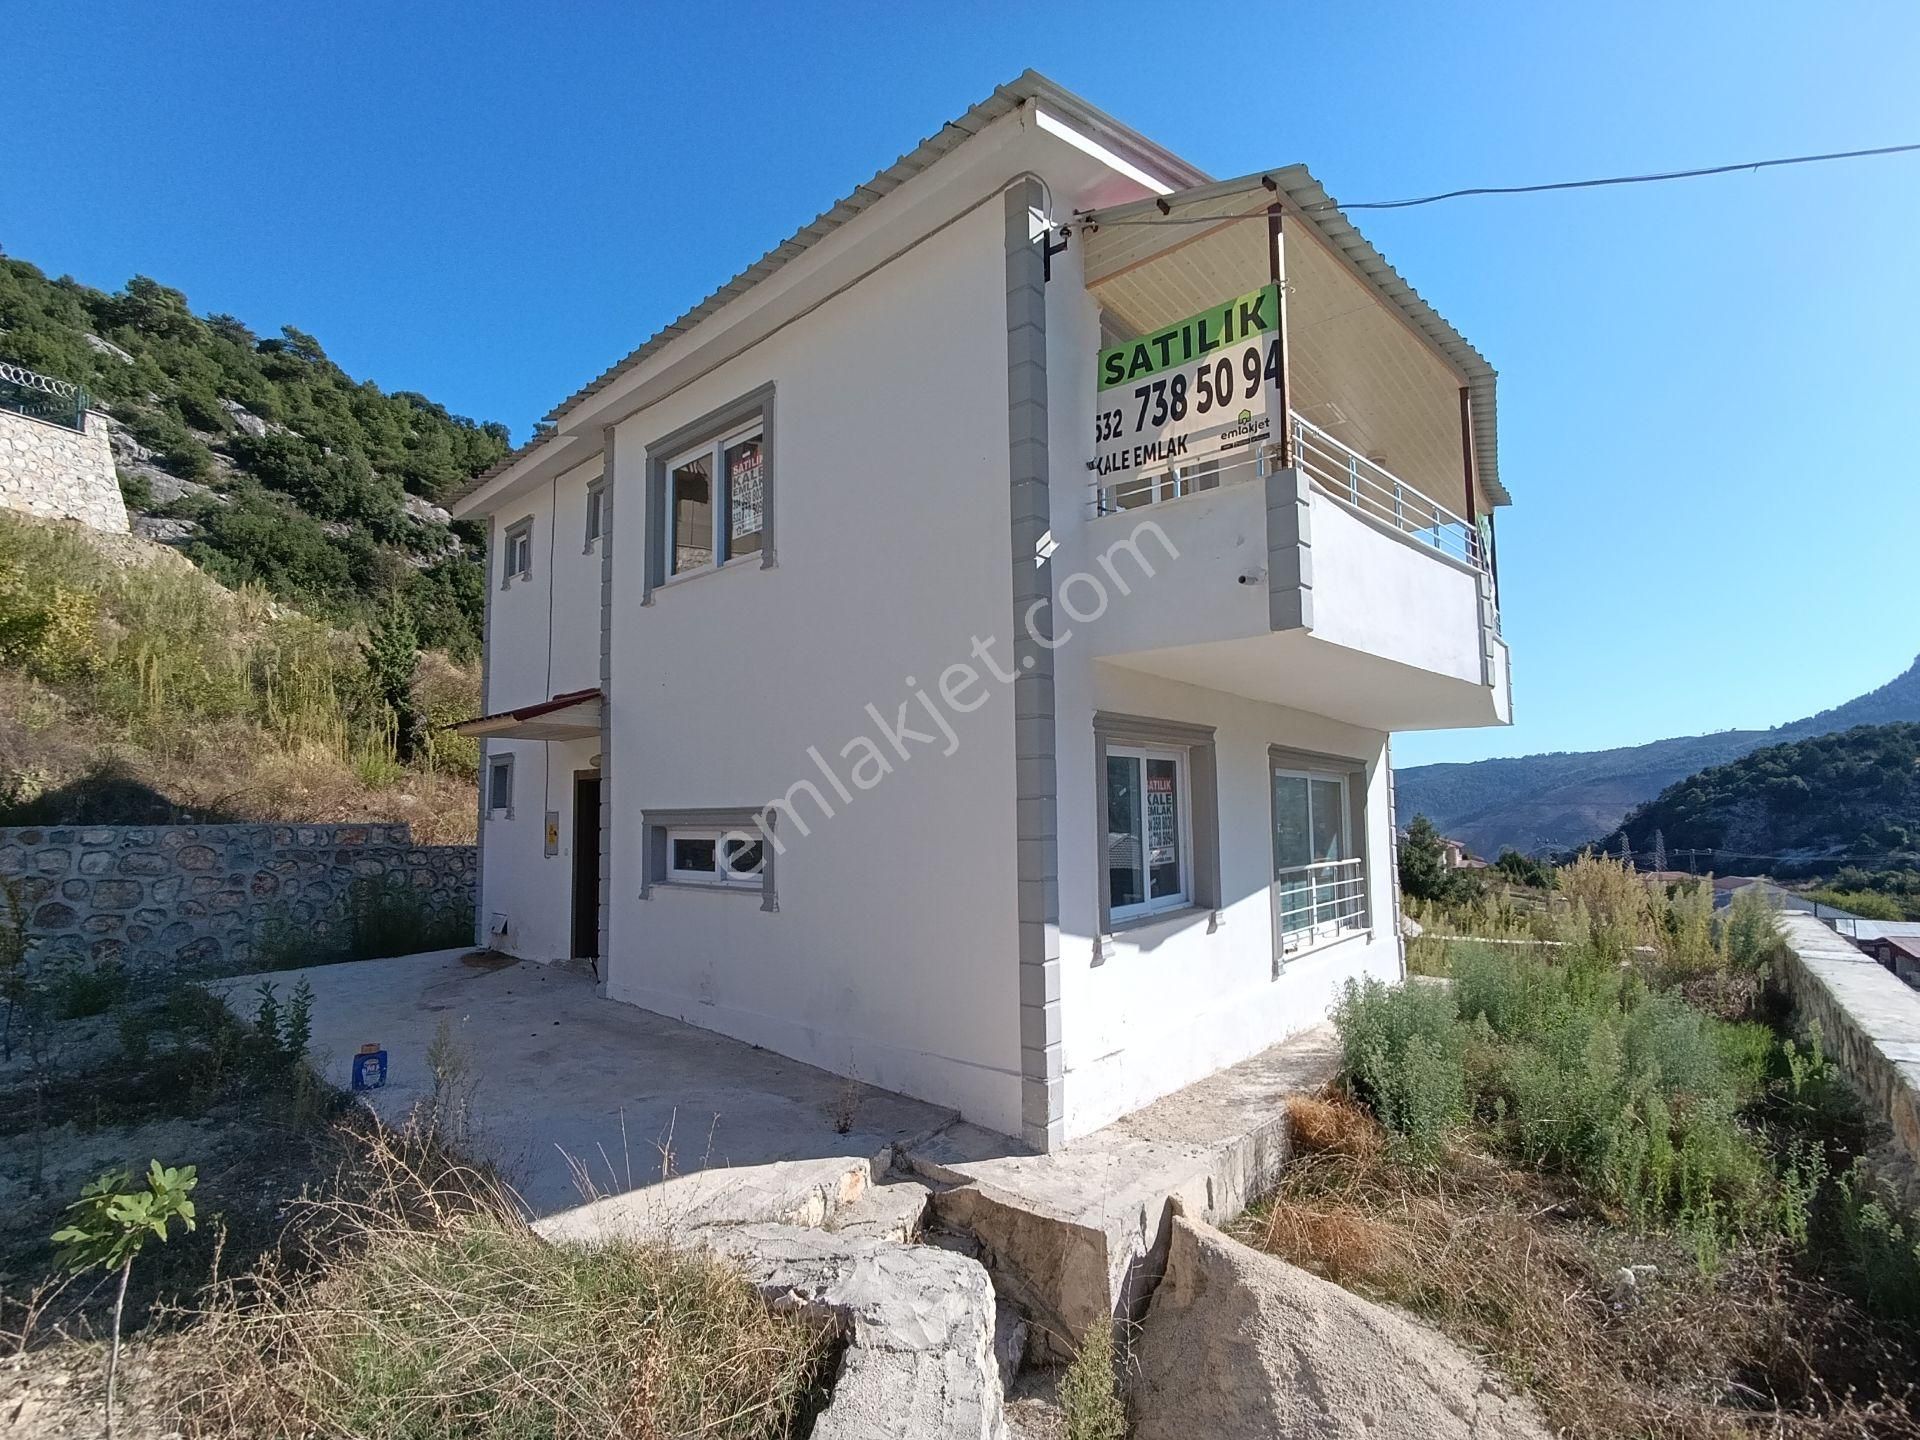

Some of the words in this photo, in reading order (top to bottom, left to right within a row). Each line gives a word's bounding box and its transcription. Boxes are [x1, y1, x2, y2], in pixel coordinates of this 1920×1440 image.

[1104, 294, 1267, 385] SATILIK
[1135, 373, 1188, 433] 738
[1196, 357, 1234, 414] 50
[1243, 339, 1281, 400] 94
[1220, 417, 1270, 440] emlakjet
[1134, 433, 1188, 468] EMLAK
[1147, 779, 1172, 791] ATILIK
